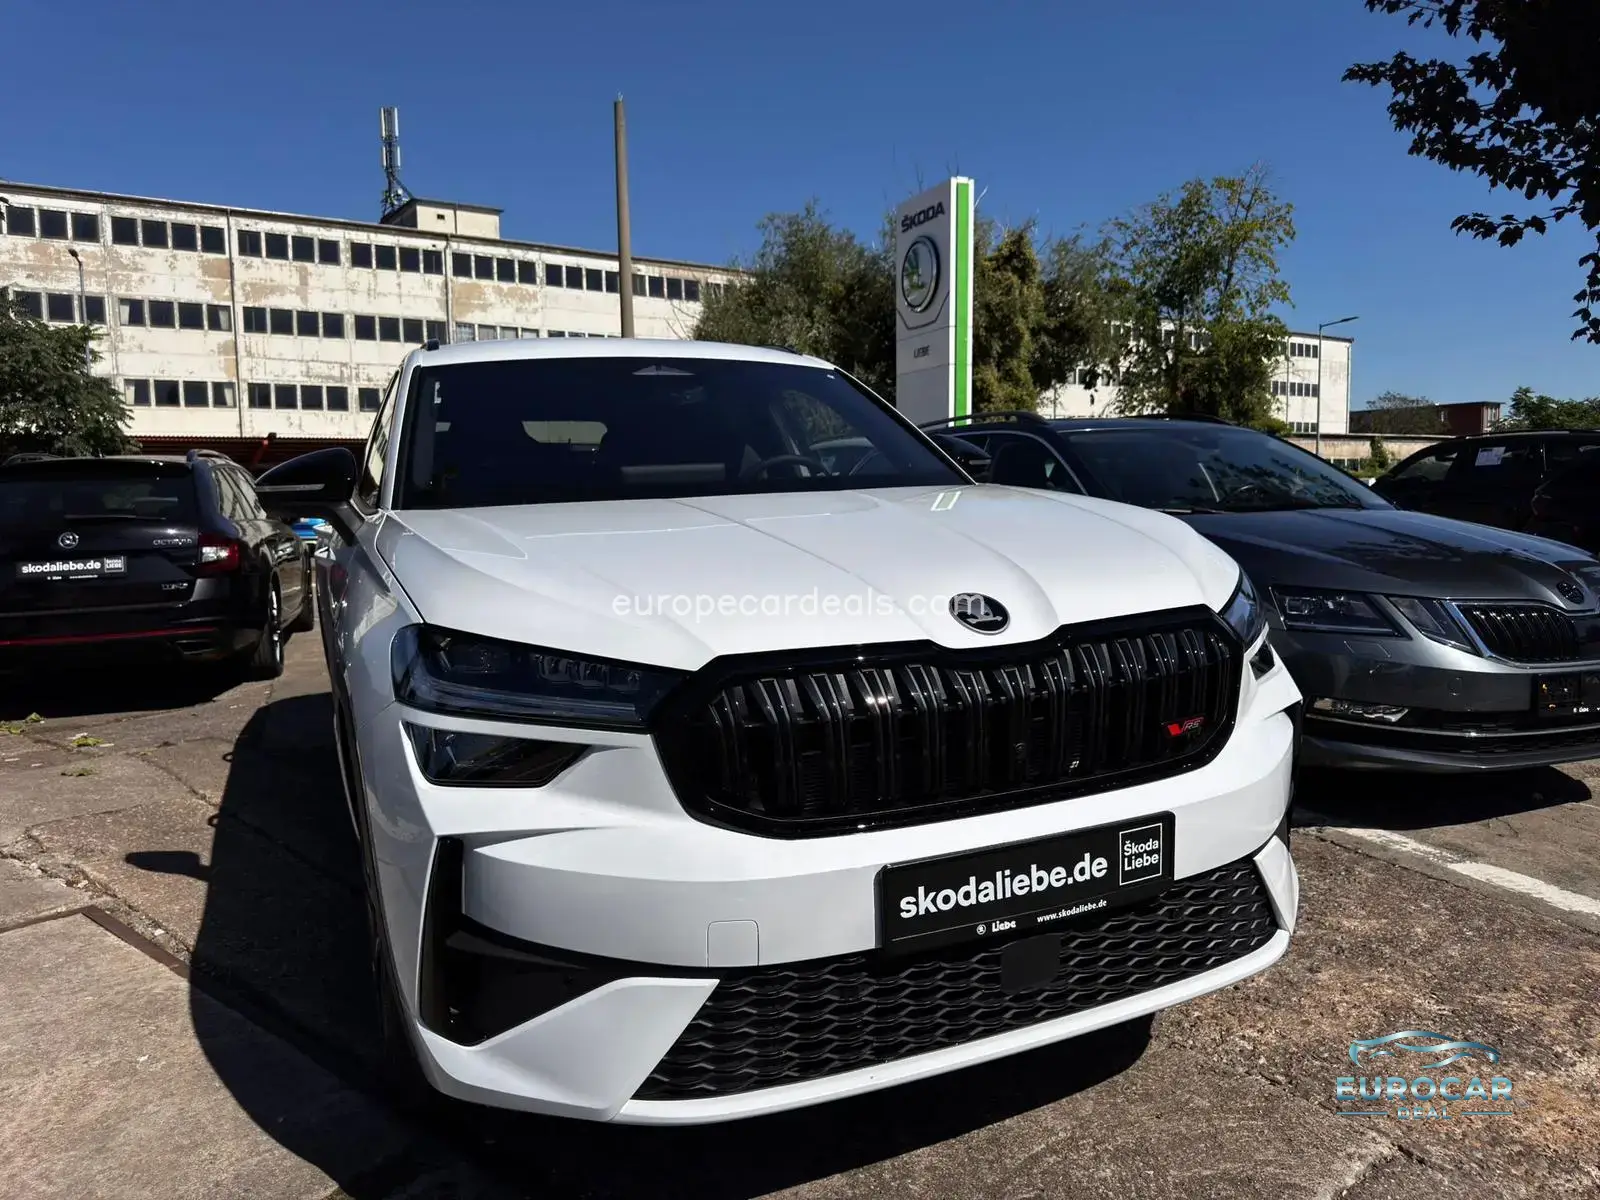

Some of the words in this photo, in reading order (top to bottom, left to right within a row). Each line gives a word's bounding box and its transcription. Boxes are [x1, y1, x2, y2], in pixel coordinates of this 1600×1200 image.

[901, 202, 945, 233] ŠKODA
[22, 561, 101, 574] skodaliebe.de
[1123, 838, 1159, 856] Škoda
[1123, 853, 1159, 872] Liebe
[899, 852, 1108, 919] skodaliebe.de
[1037, 899, 1108, 923] www.skodaliebe.de
[991, 919, 1017, 933] Liebe
